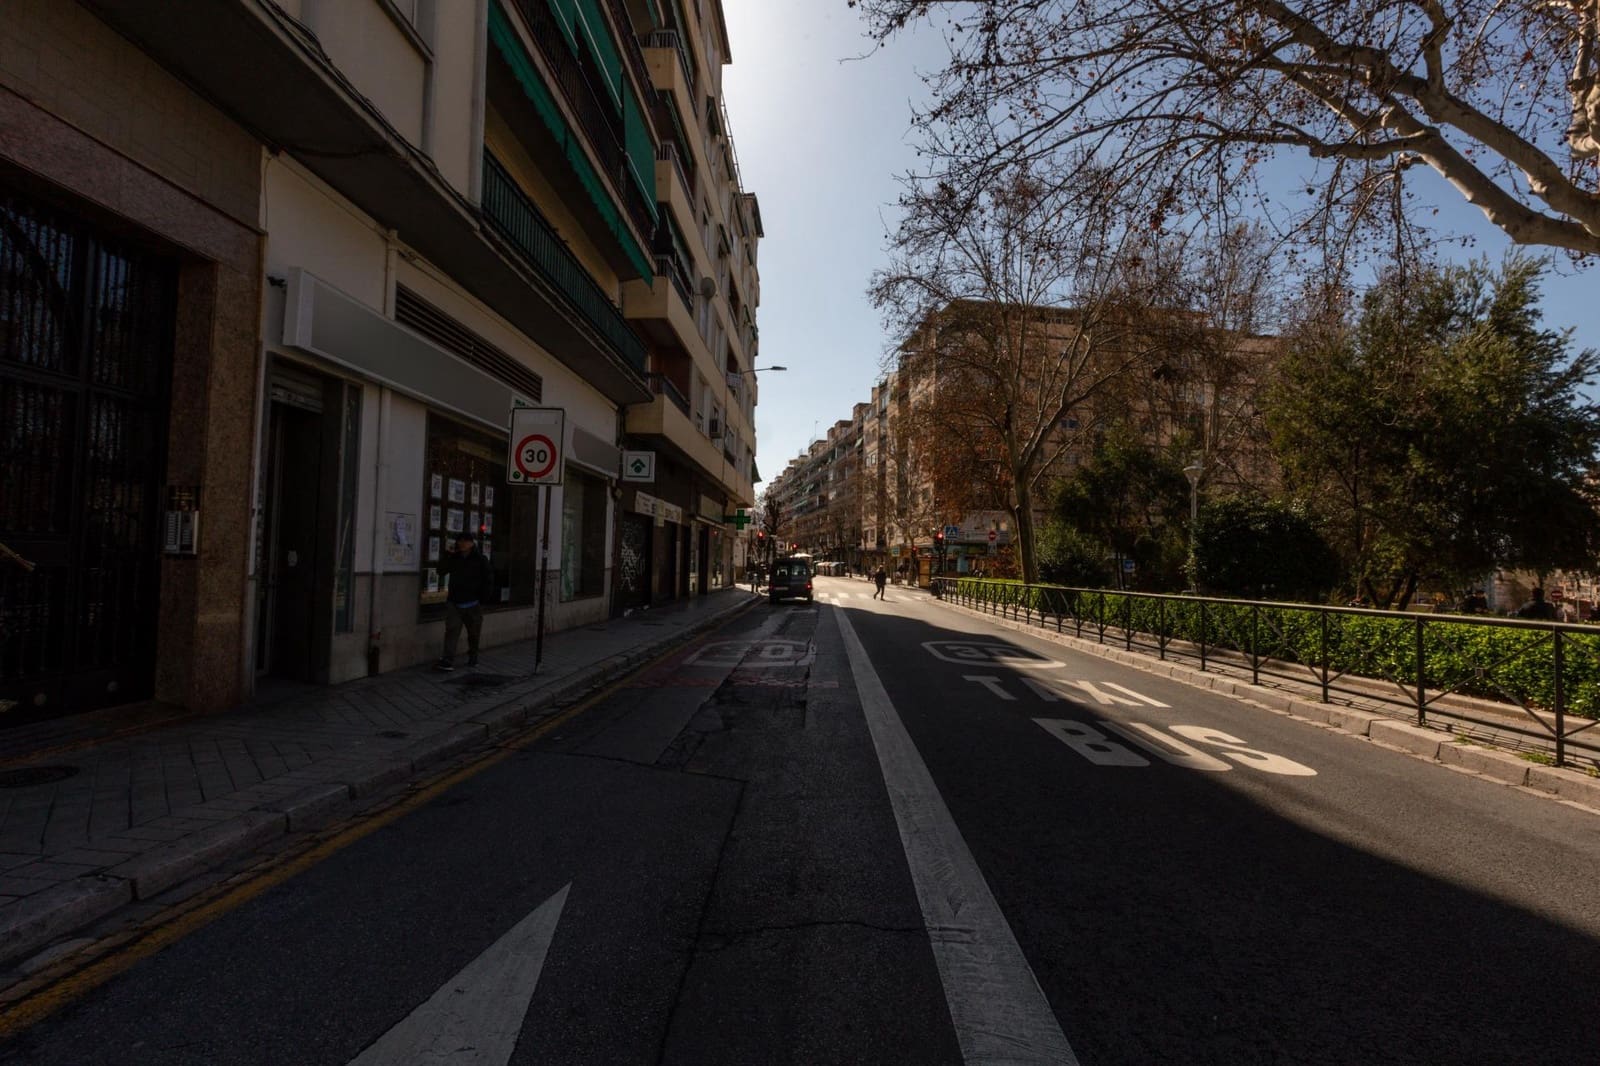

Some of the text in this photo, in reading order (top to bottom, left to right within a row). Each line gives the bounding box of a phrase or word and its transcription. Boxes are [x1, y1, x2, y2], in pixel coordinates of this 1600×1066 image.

[525, 449, 547, 463] 30
[944, 645, 1035, 662] 30
[962, 675, 1173, 708] TAXI
[1031, 717, 1319, 777] BUS
